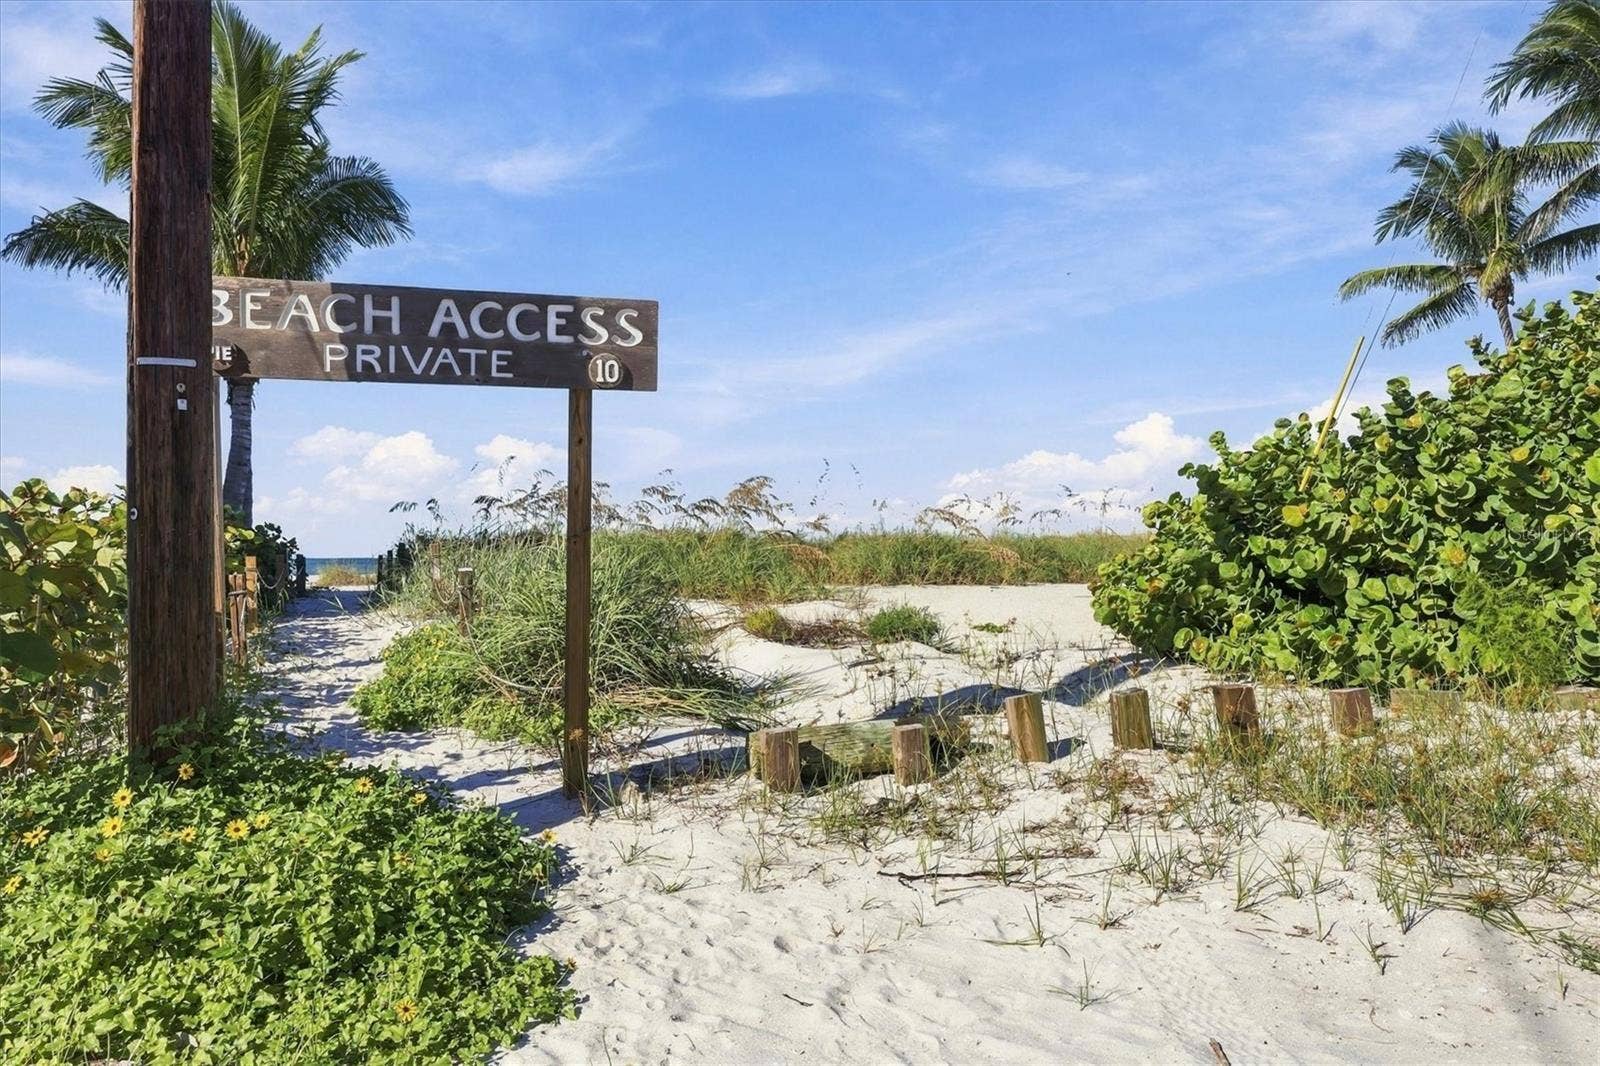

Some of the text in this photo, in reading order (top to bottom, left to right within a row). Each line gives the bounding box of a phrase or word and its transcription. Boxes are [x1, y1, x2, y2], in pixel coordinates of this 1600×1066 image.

[212, 288, 643, 347] BEACH ACCESS
[211, 345, 232, 360] IE
[323, 343, 514, 378] PRIVATE
[595, 359, 620, 383] 10
